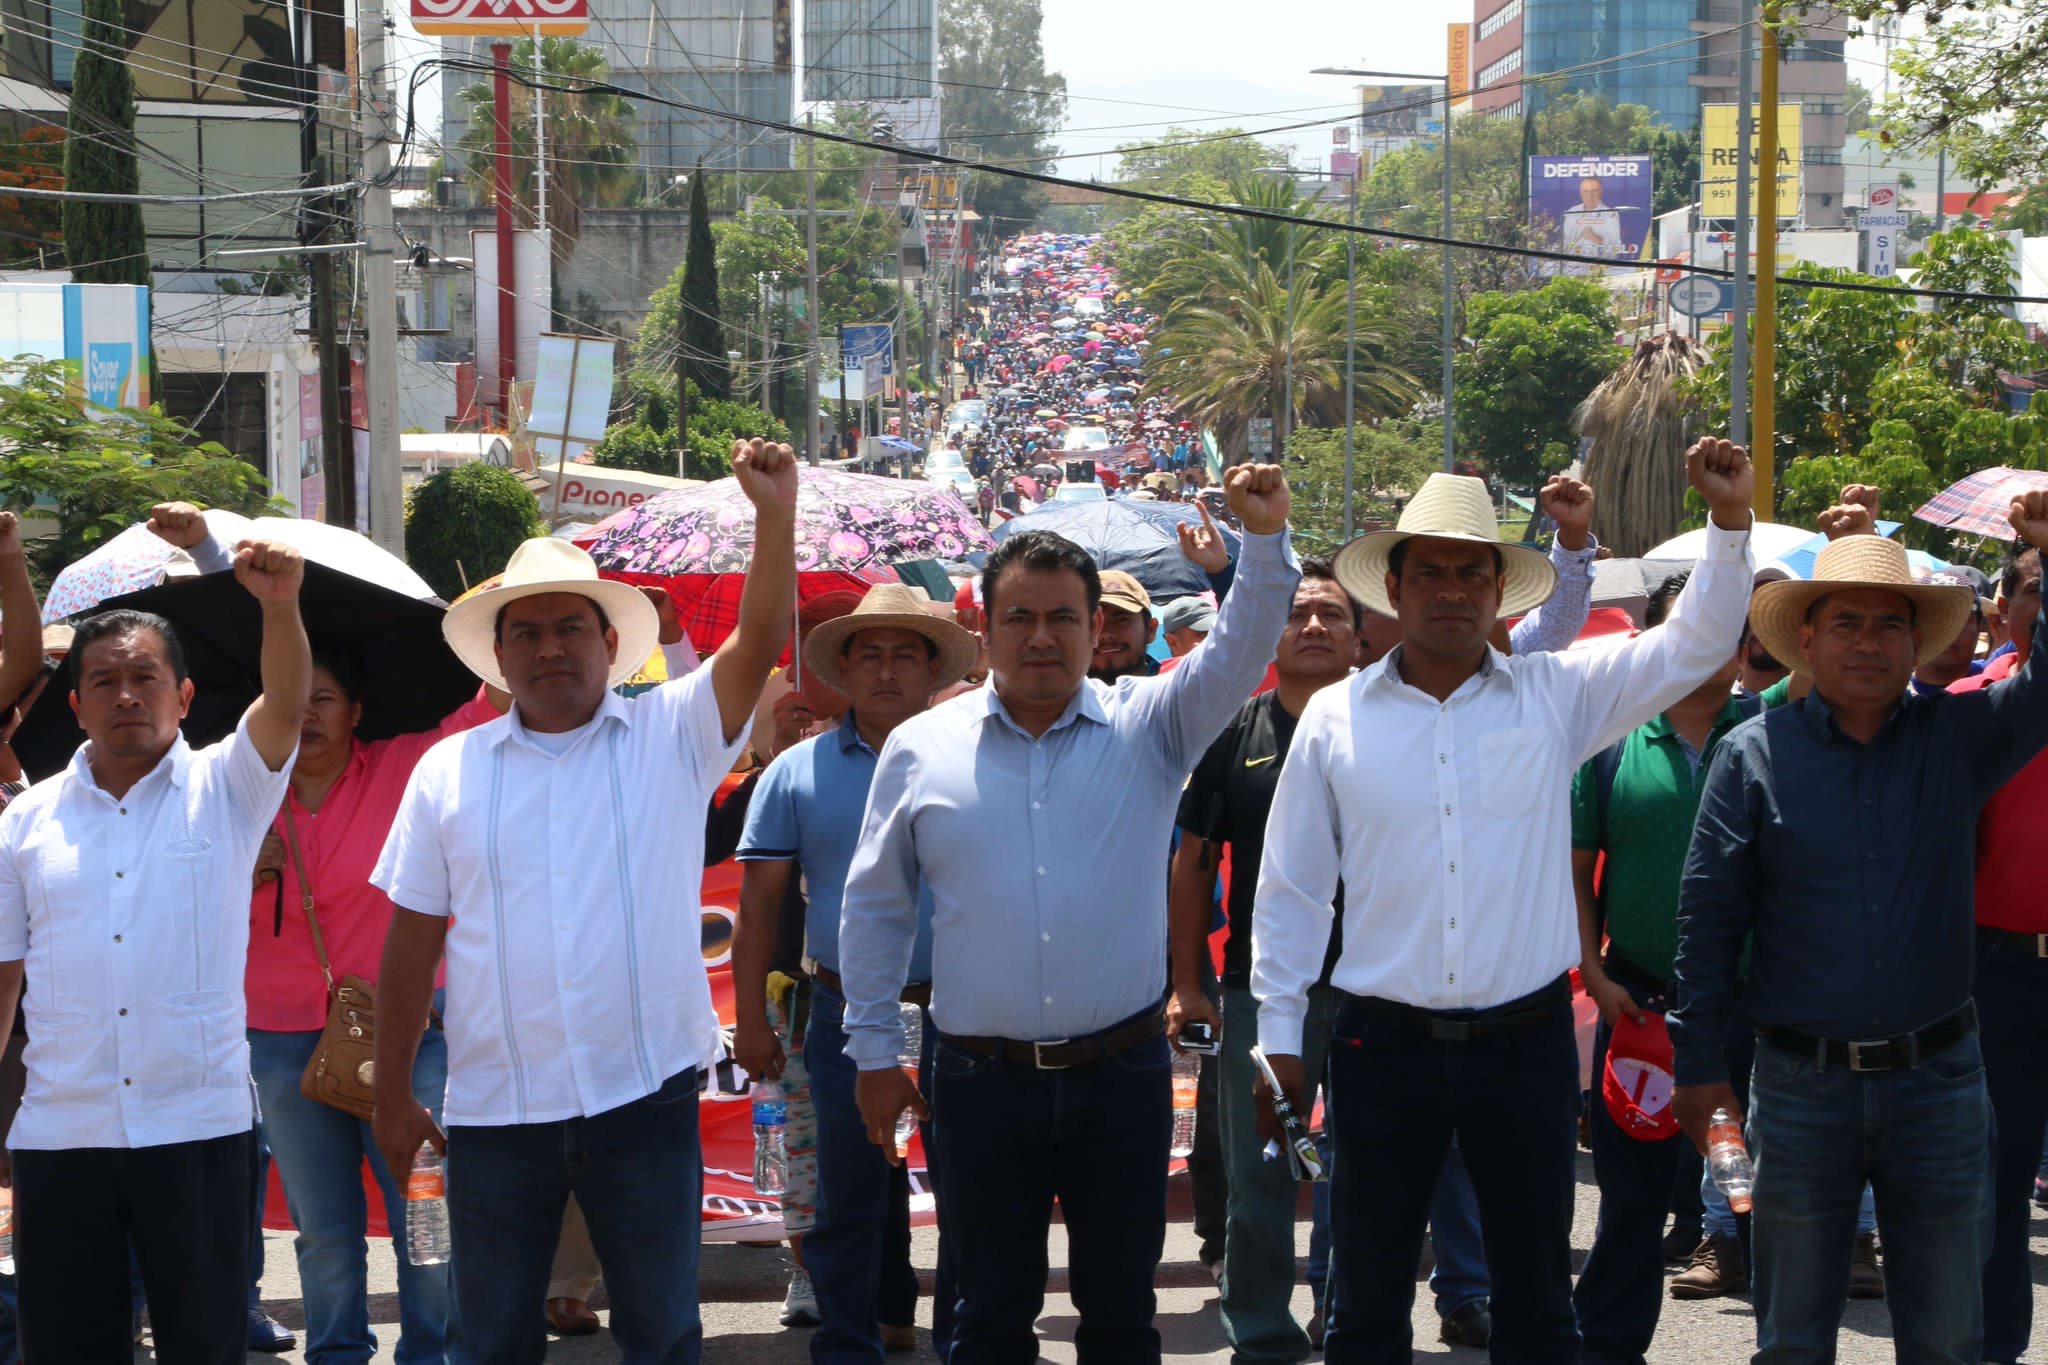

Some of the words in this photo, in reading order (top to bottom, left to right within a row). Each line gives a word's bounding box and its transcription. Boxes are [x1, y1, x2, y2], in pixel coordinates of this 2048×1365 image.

[1451, 30, 1465, 83] elektra
[1711, 147, 1791, 166] RENA
[1543, 163, 1639, 178] DEFENDER
[1860, 215, 1906, 226] FARMACIAS
[91, 350, 119, 402] Sayer
